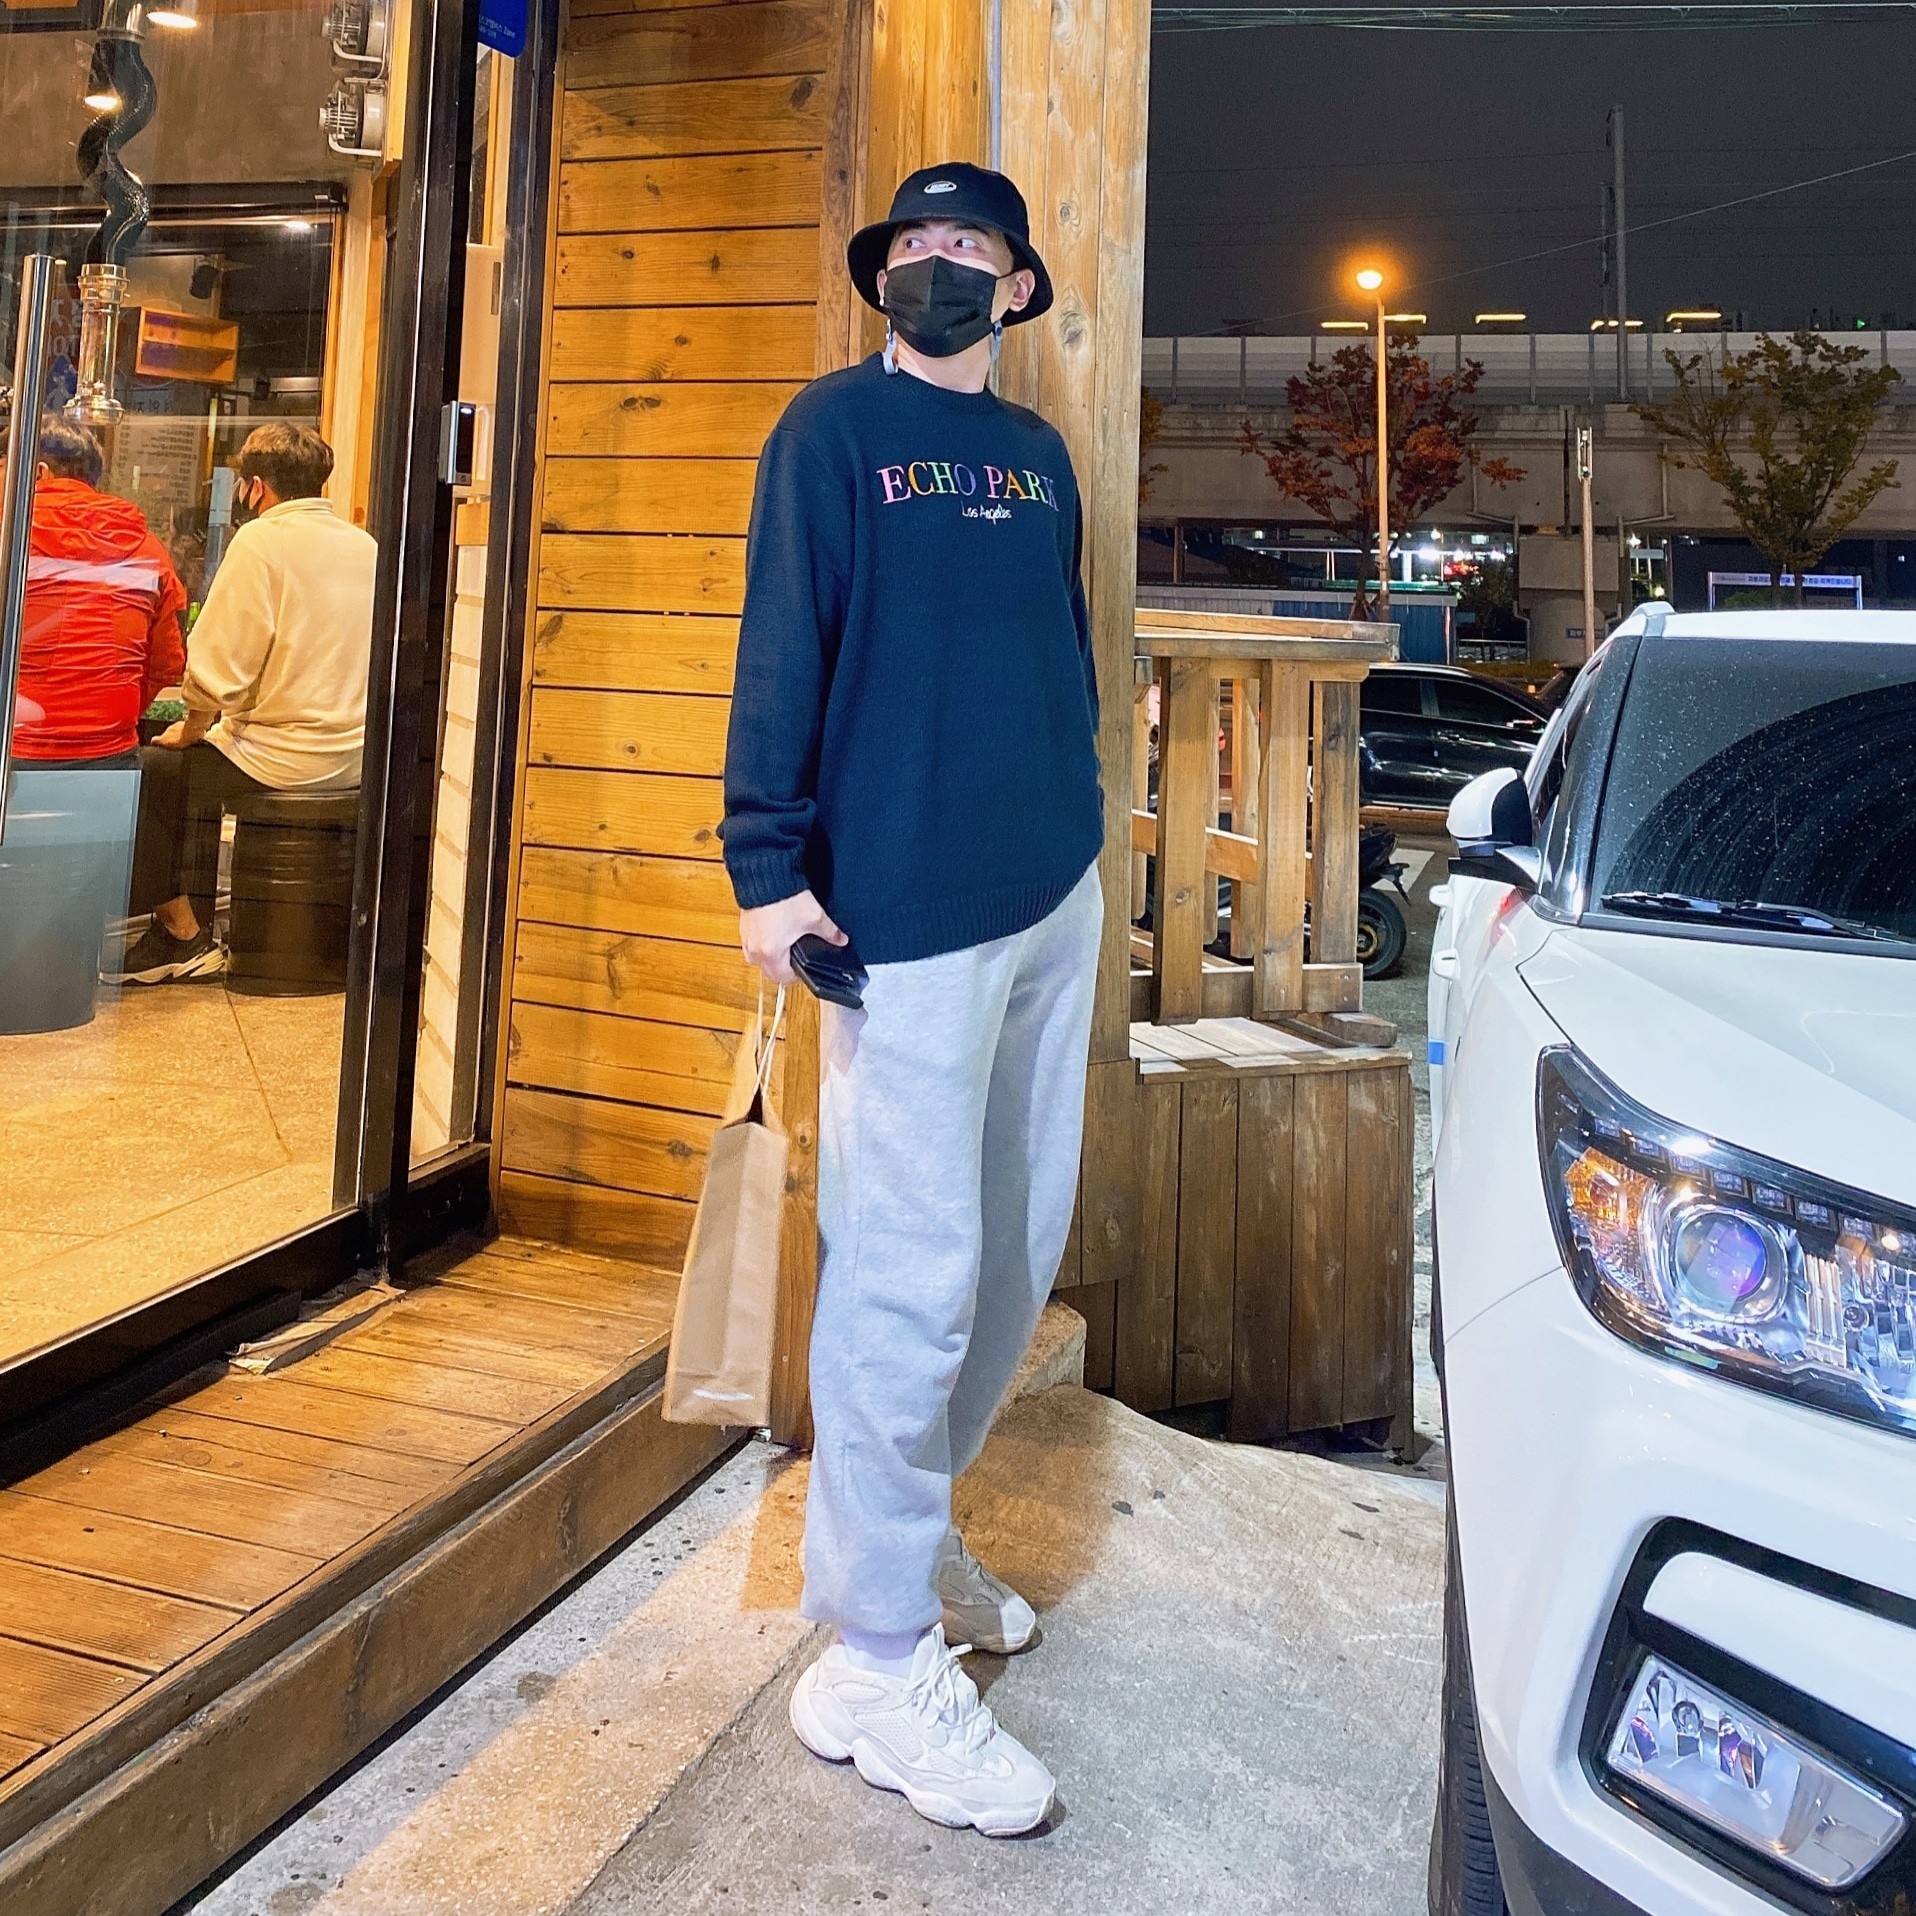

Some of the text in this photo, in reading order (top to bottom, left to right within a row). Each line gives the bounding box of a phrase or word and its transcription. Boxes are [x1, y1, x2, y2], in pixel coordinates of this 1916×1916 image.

[876, 461, 1060, 512] ECHO PARK
[960, 500, 1012, 525] Los Angeles
